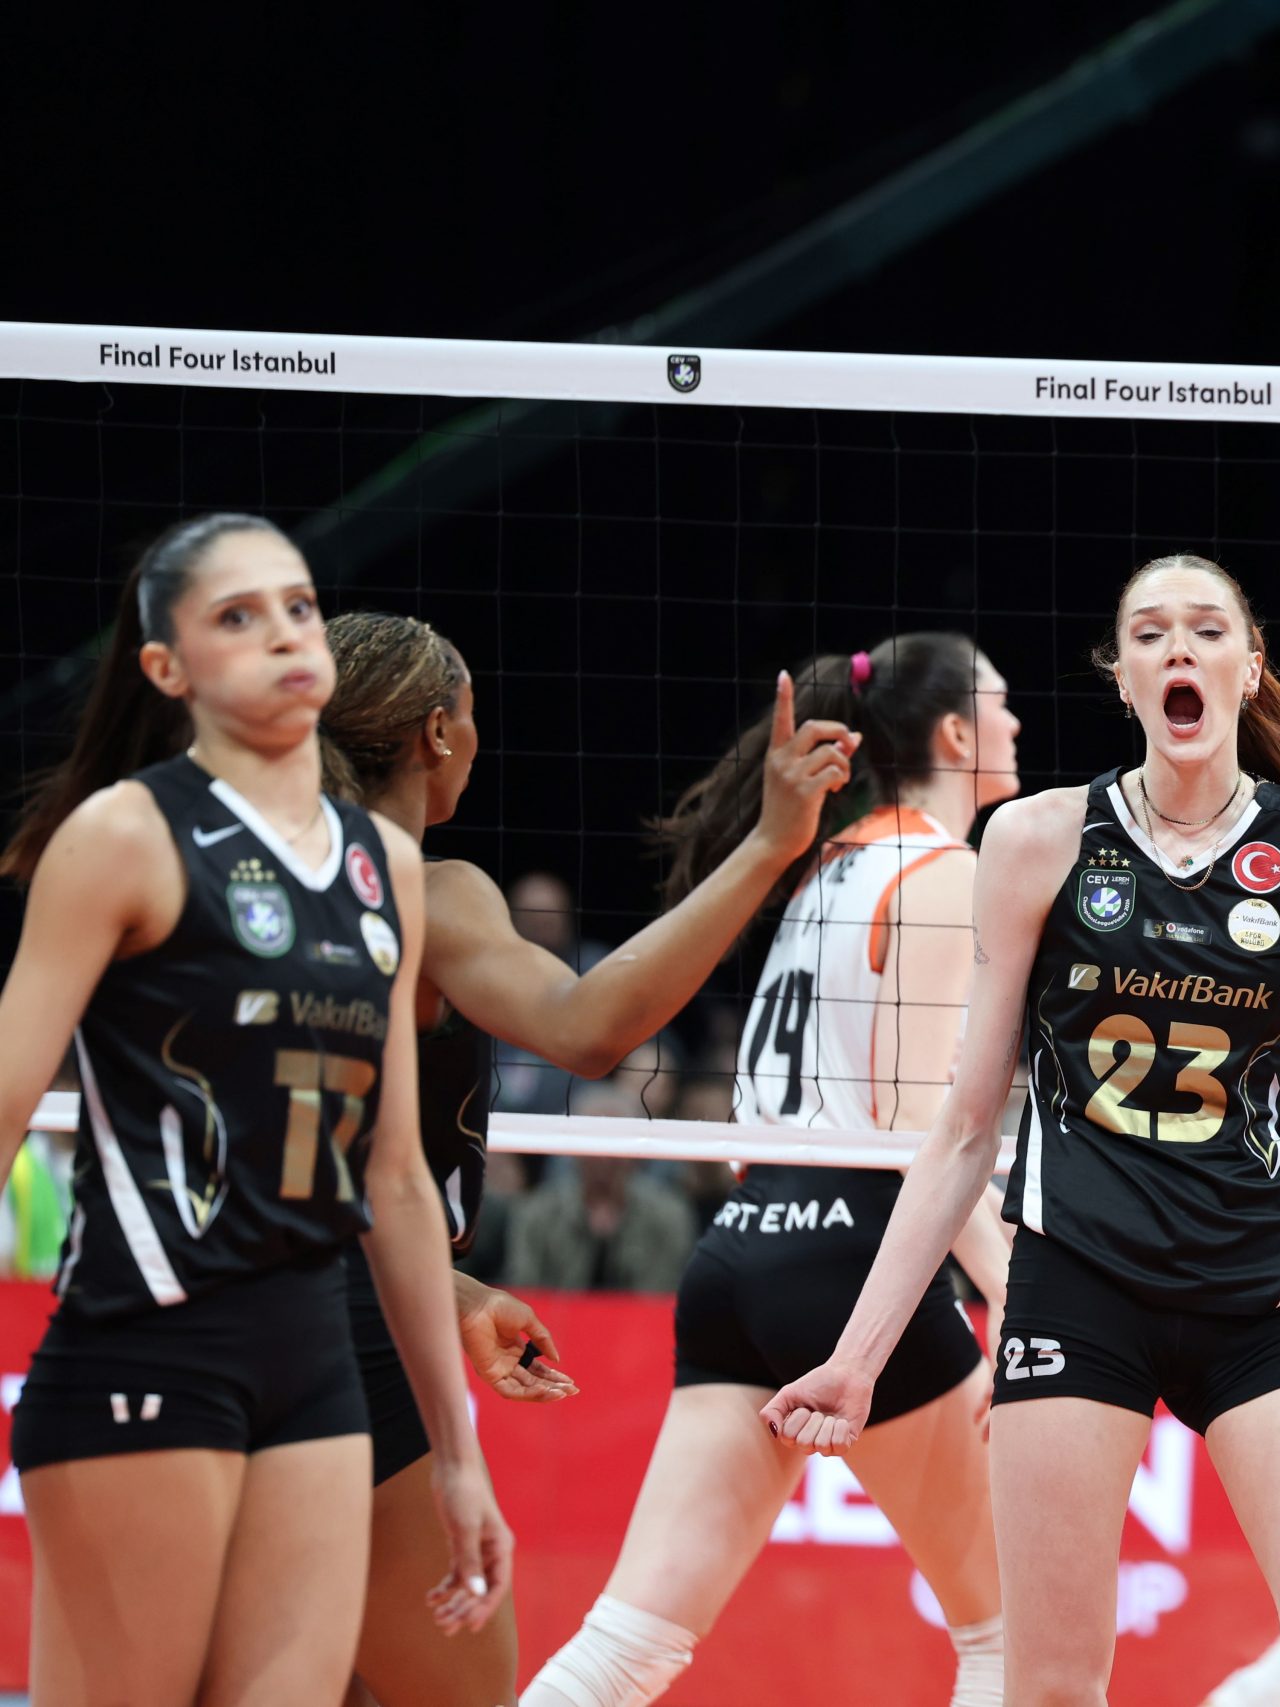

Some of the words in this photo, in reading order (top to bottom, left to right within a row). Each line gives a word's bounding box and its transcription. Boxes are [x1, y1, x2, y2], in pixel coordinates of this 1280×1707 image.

[100, 343, 160, 367] Final
[170, 347, 225, 370] Four
[233, 349, 336, 374] Istanbul
[1036, 376, 1096, 399] Final
[1105, 379, 1160, 402] Four
[1169, 381, 1272, 405] Istanbul
[1087, 875, 1109, 884] CEV
[1177, 927, 1204, 935] vodafone
[1084, 1013, 1231, 1143] 23
[1004, 1337, 1066, 1380] 23
